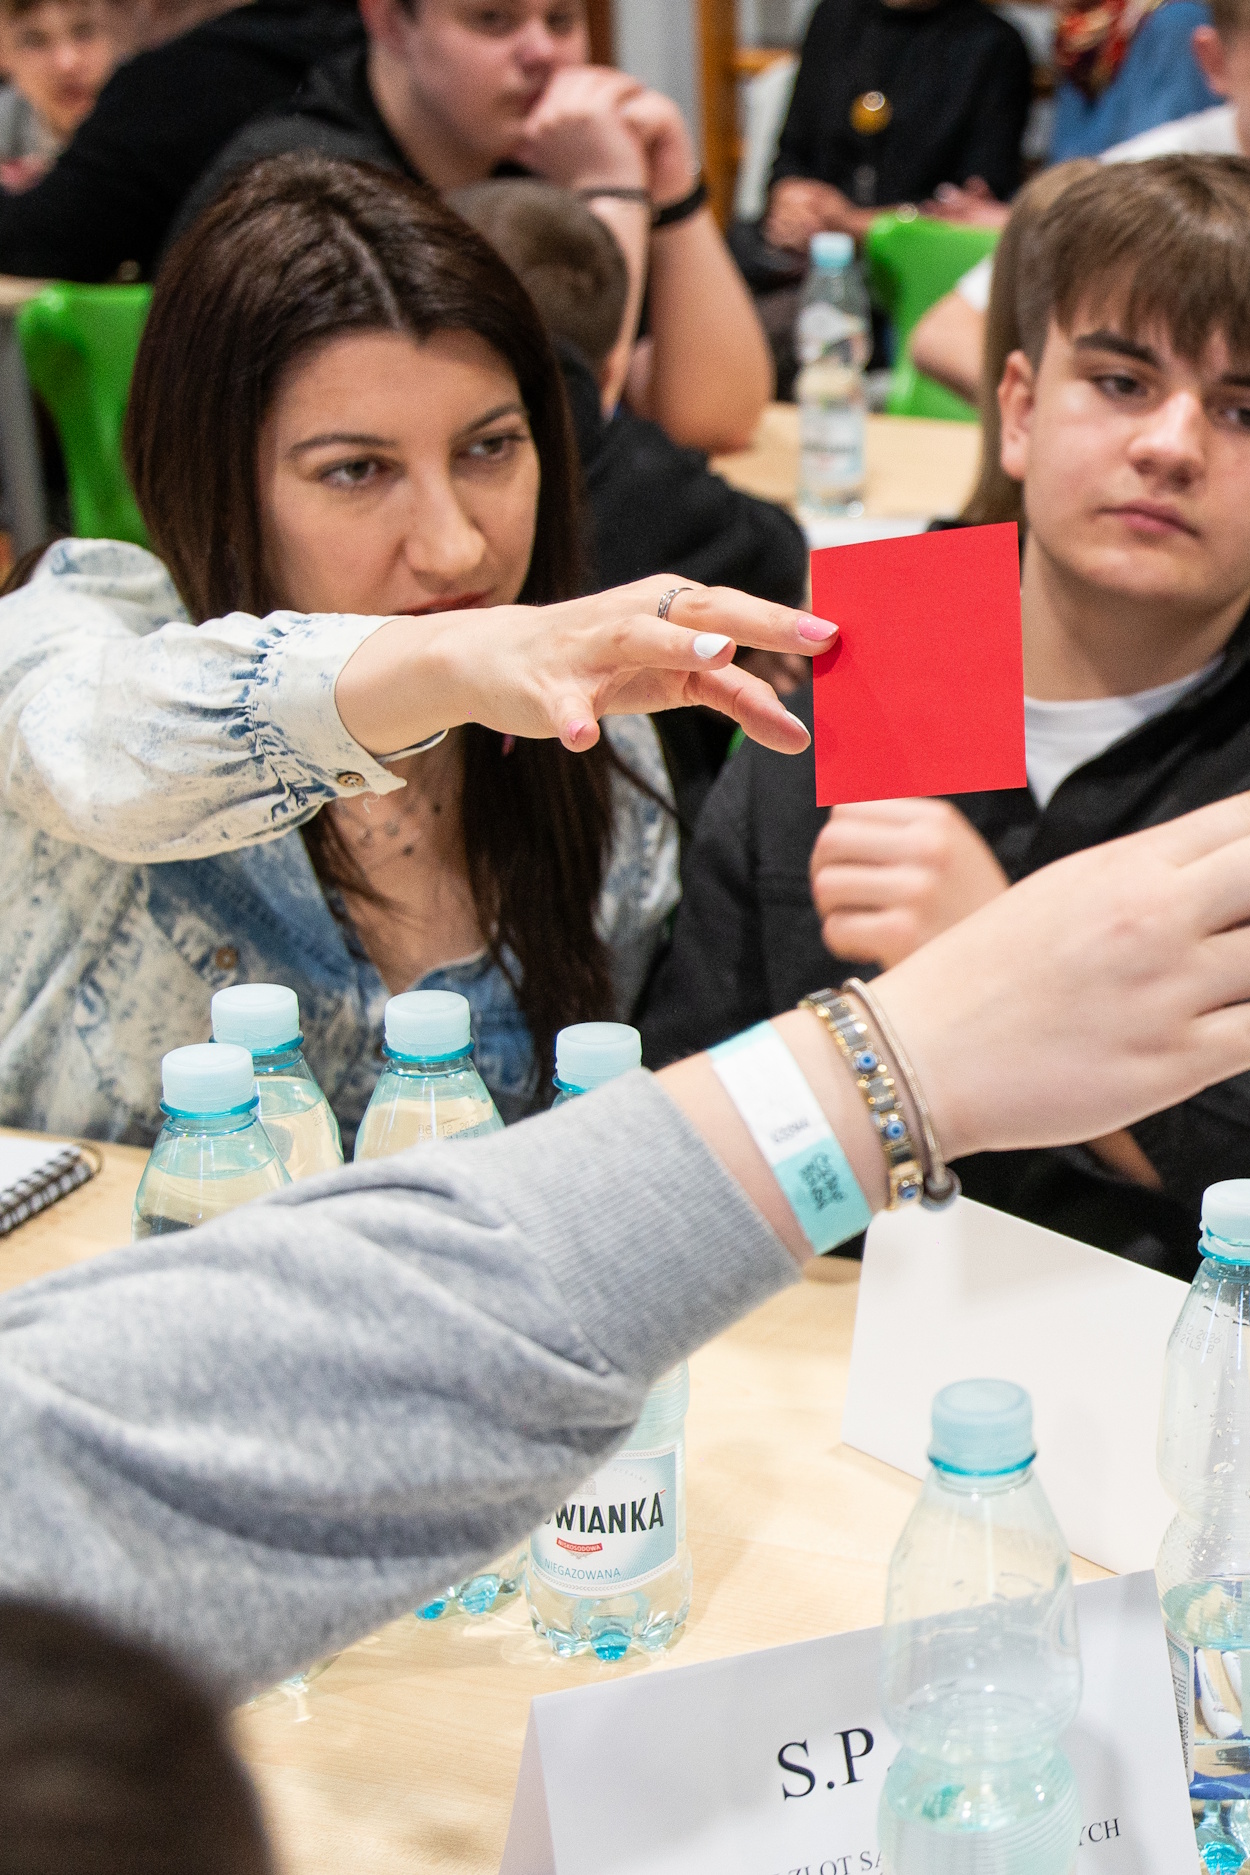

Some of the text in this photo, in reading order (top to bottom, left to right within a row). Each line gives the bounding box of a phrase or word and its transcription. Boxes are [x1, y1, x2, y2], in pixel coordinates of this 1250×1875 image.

[545, 1490, 664, 1533] WIANKA
[545, 1558, 621, 1580] NIEGAZOWANA
[777, 1727, 890, 1801] S.P
